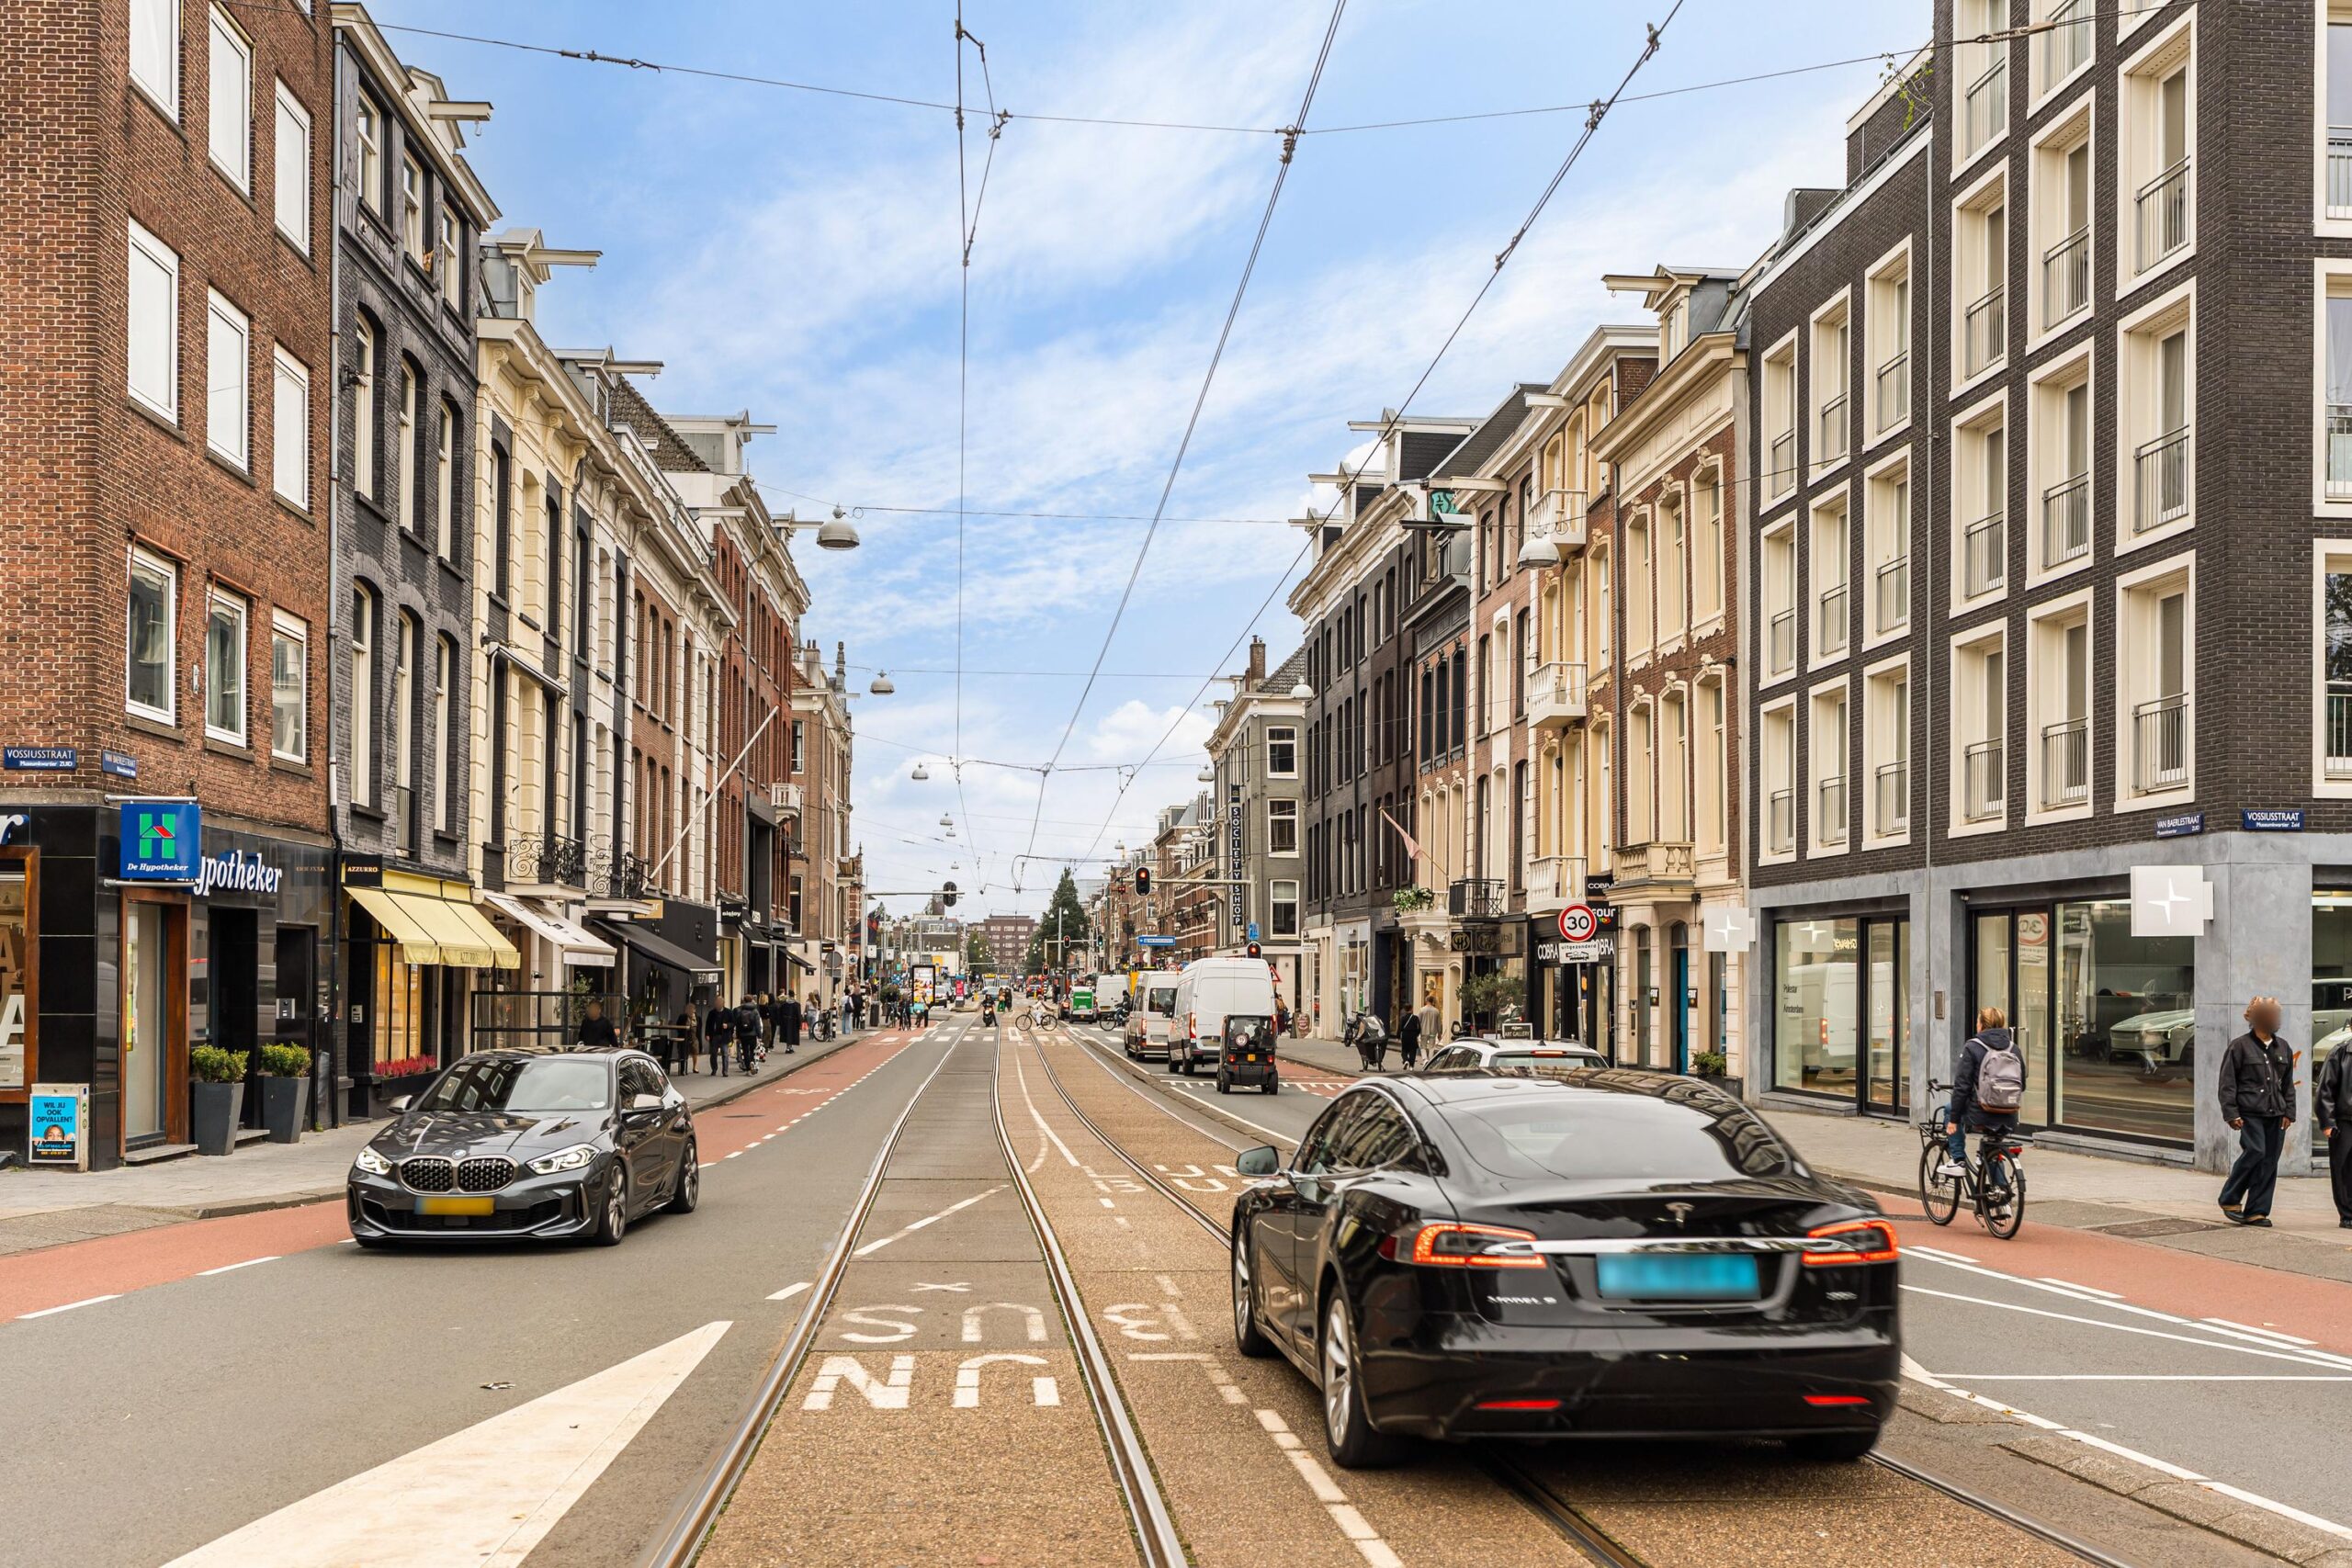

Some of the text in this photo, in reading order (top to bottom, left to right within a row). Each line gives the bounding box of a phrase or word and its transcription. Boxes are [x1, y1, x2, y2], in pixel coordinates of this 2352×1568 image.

[6, 749, 73, 760] VOSSIUSSTRAAT
[2156, 815, 2200, 829] VAN BAERLESTRAAT
[2246, 812, 2300, 821] VOSSIUSSTRAAT
[127, 863, 189, 872] De Hypotheker
[193, 850, 283, 897] ypotheker
[1566, 915, 1589, 931] 30
[1538, 943, 1558, 960] COBRA
[1783, 984, 1797, 993] Polestar
[1783, 1005, 1804, 1013] Amsterdam
